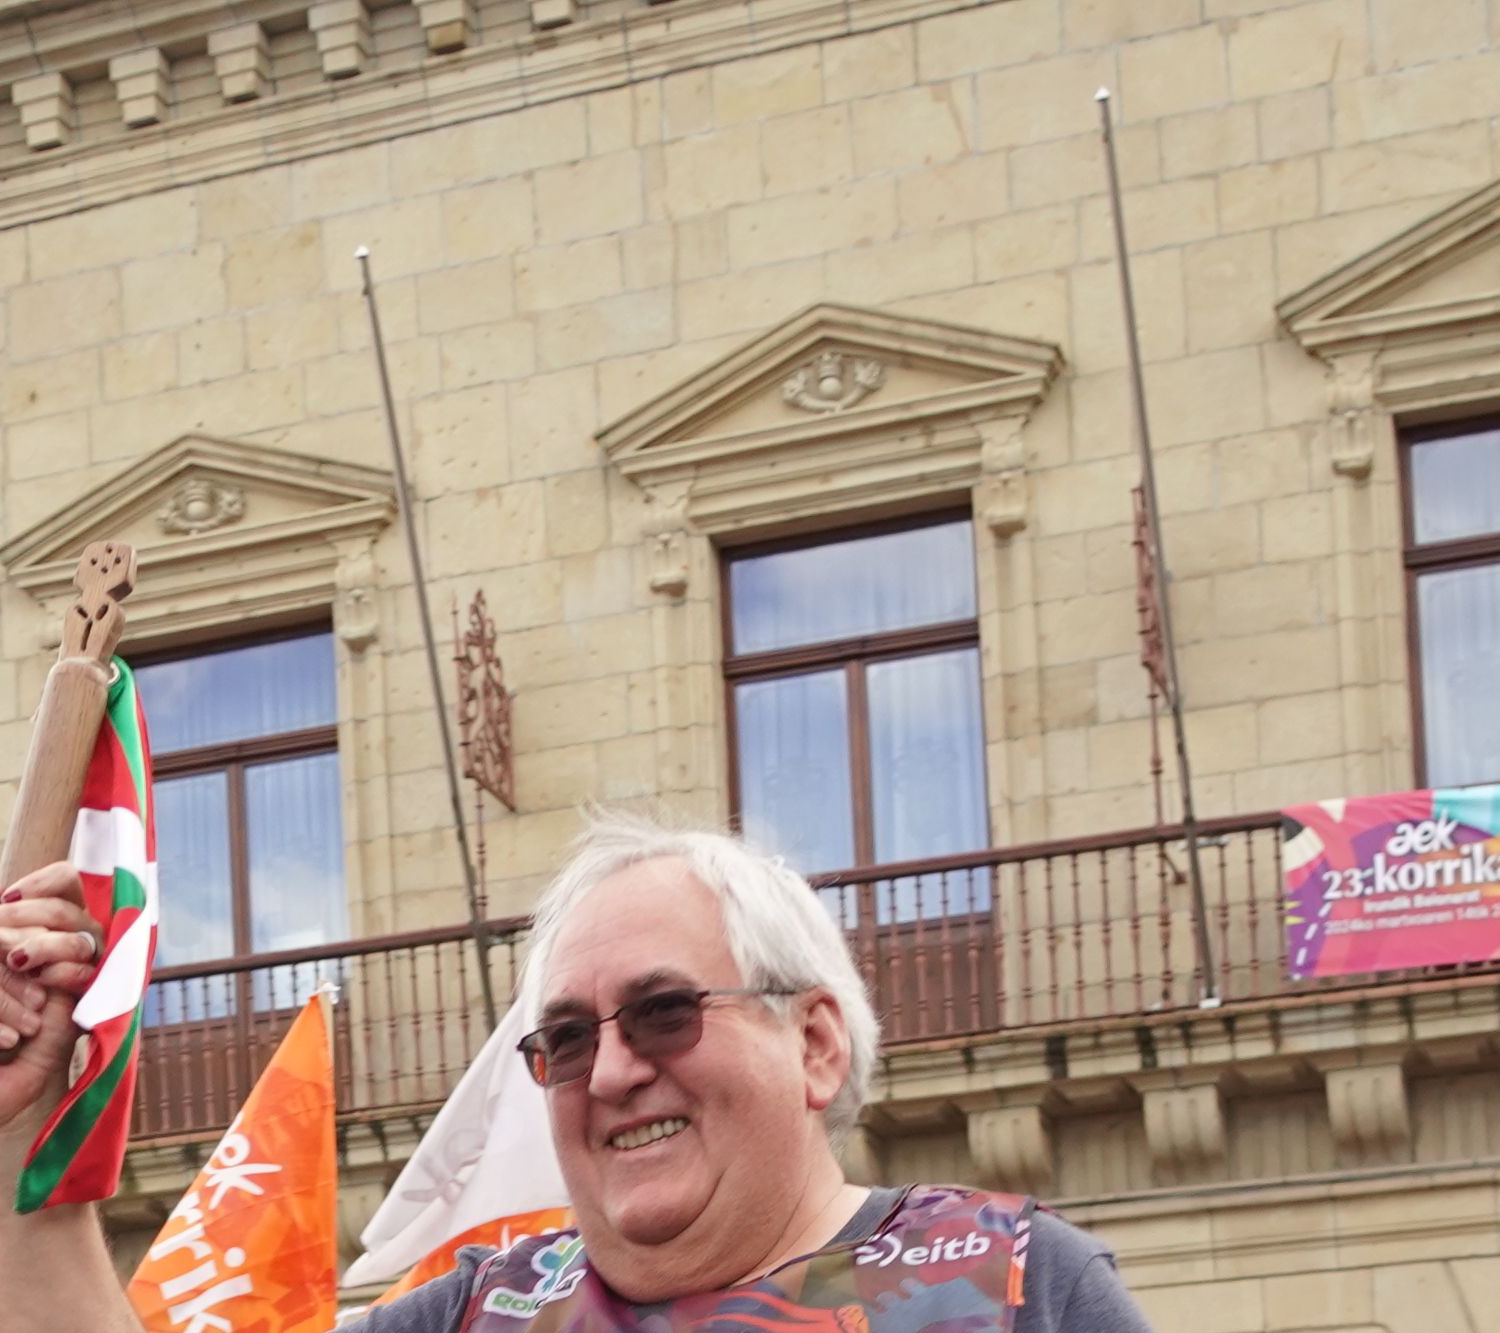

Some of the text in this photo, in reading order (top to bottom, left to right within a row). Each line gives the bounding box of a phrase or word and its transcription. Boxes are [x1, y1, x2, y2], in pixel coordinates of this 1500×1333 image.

[1386, 808, 1461, 856] aek
[203, 1113, 284, 1210] ek
[902, 1232, 991, 1266] eitb
